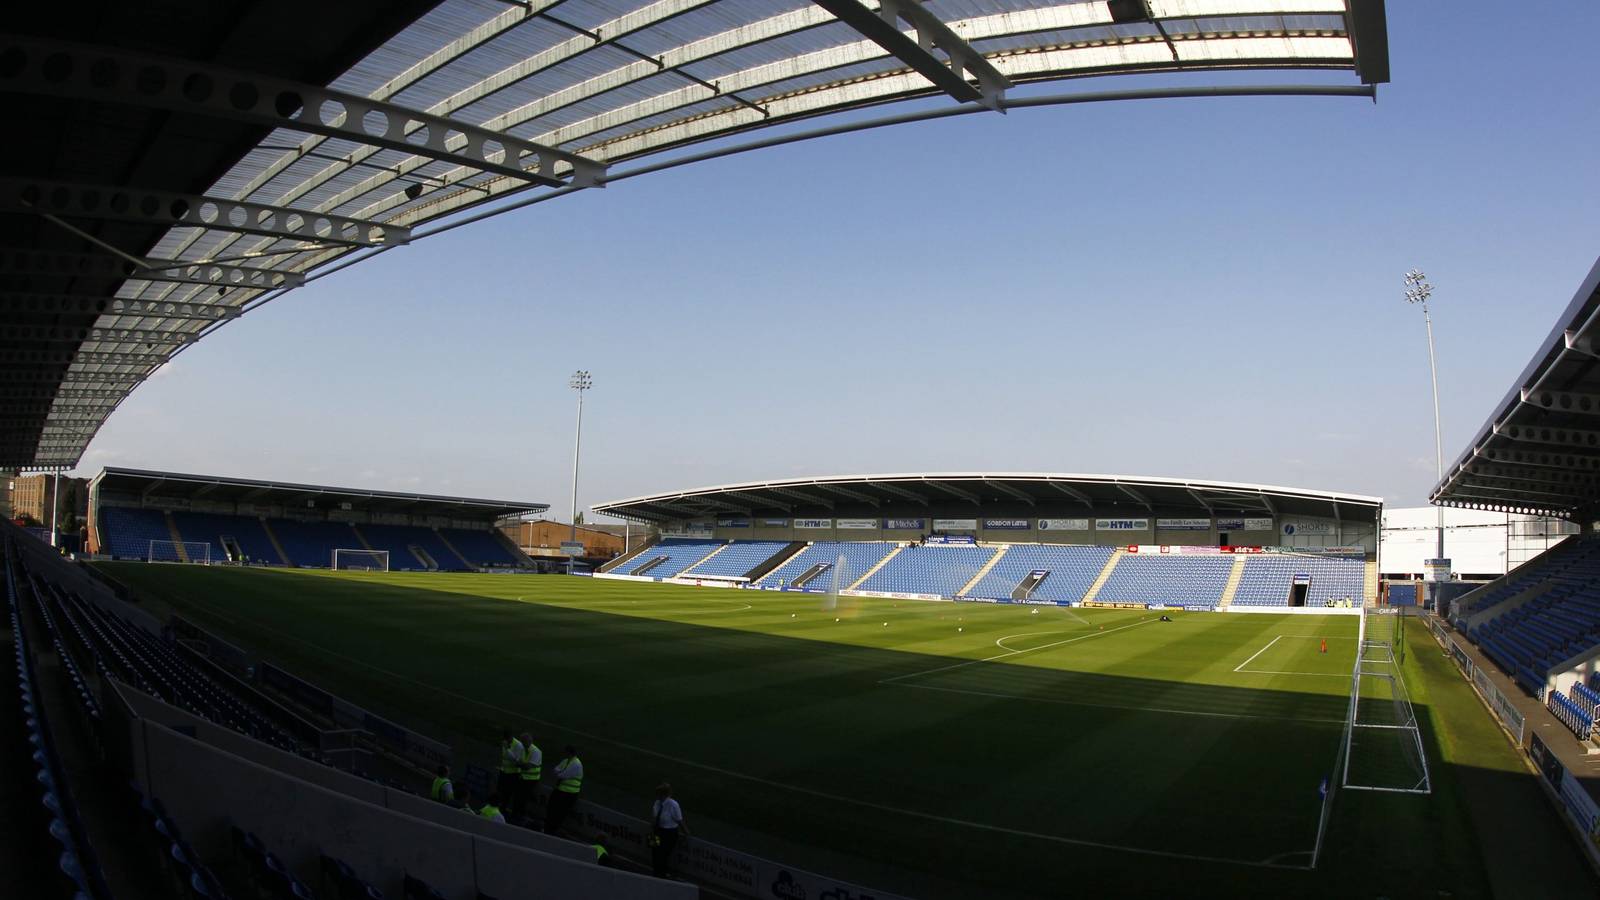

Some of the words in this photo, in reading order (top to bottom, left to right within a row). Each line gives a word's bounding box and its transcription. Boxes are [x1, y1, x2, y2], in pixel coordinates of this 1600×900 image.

[1110, 520, 1133, 528] HTM
[1297, 522, 1330, 530] SHORTS
[586, 813, 643, 845] Supplies
